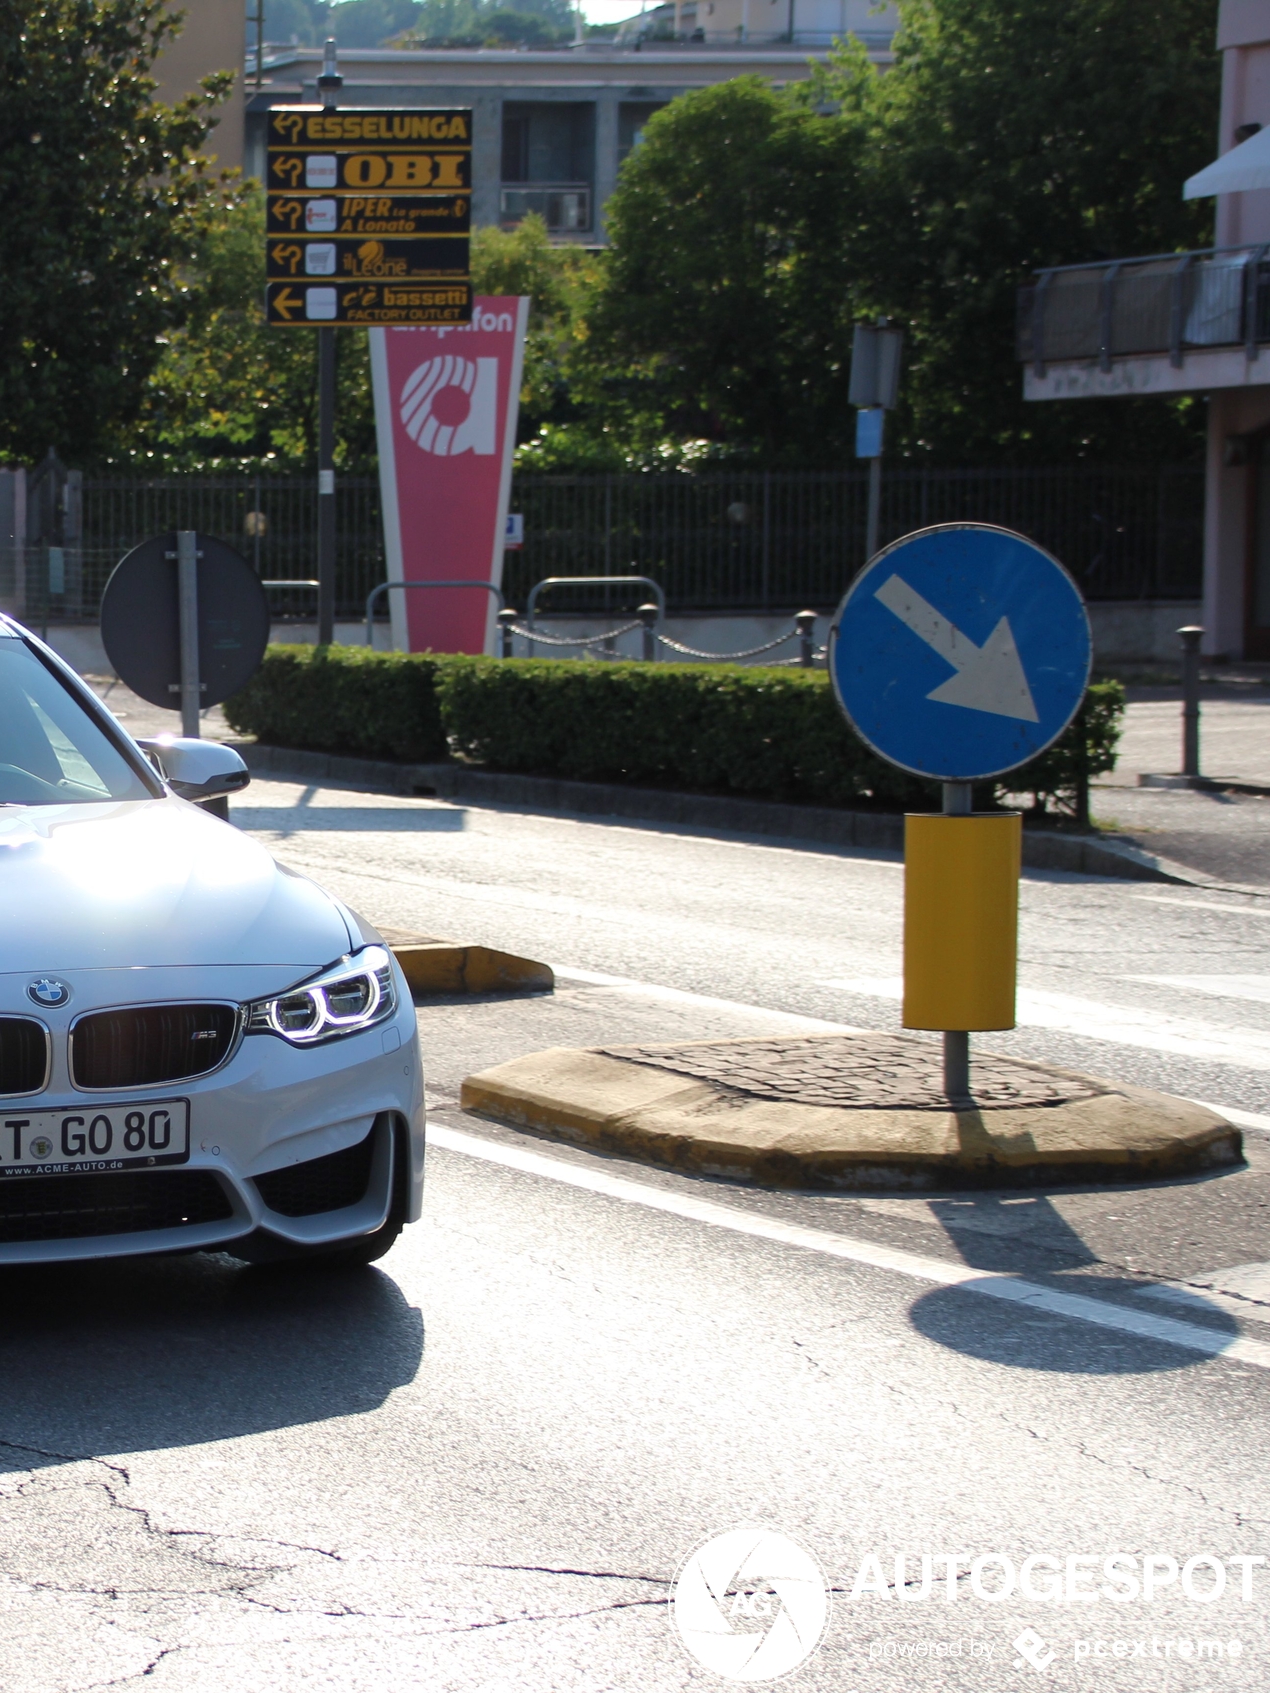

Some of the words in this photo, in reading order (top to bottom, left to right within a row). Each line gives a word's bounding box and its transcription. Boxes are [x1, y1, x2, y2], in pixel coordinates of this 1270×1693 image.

[306, 115, 467, 139] ESSELUNGA
[342, 154, 466, 188] OBI
[342, 198, 392, 217] IPER
[408, 208, 450, 219] grande
[340, 219, 353, 231] A
[357, 219, 416, 232] Lonato
[352, 257, 408, 276] Leone
[383, 287, 468, 306] bassetti
[346, 309, 408, 321] FACTORY
[409, 308, 462, 320] OUTLET
[29, 978, 64, 989] BMW
[60, 1113, 114, 1157] GO
[122, 1109, 172, 1152] 80
[4, 1160, 124, 1176] www.ACME-AUTO.de
